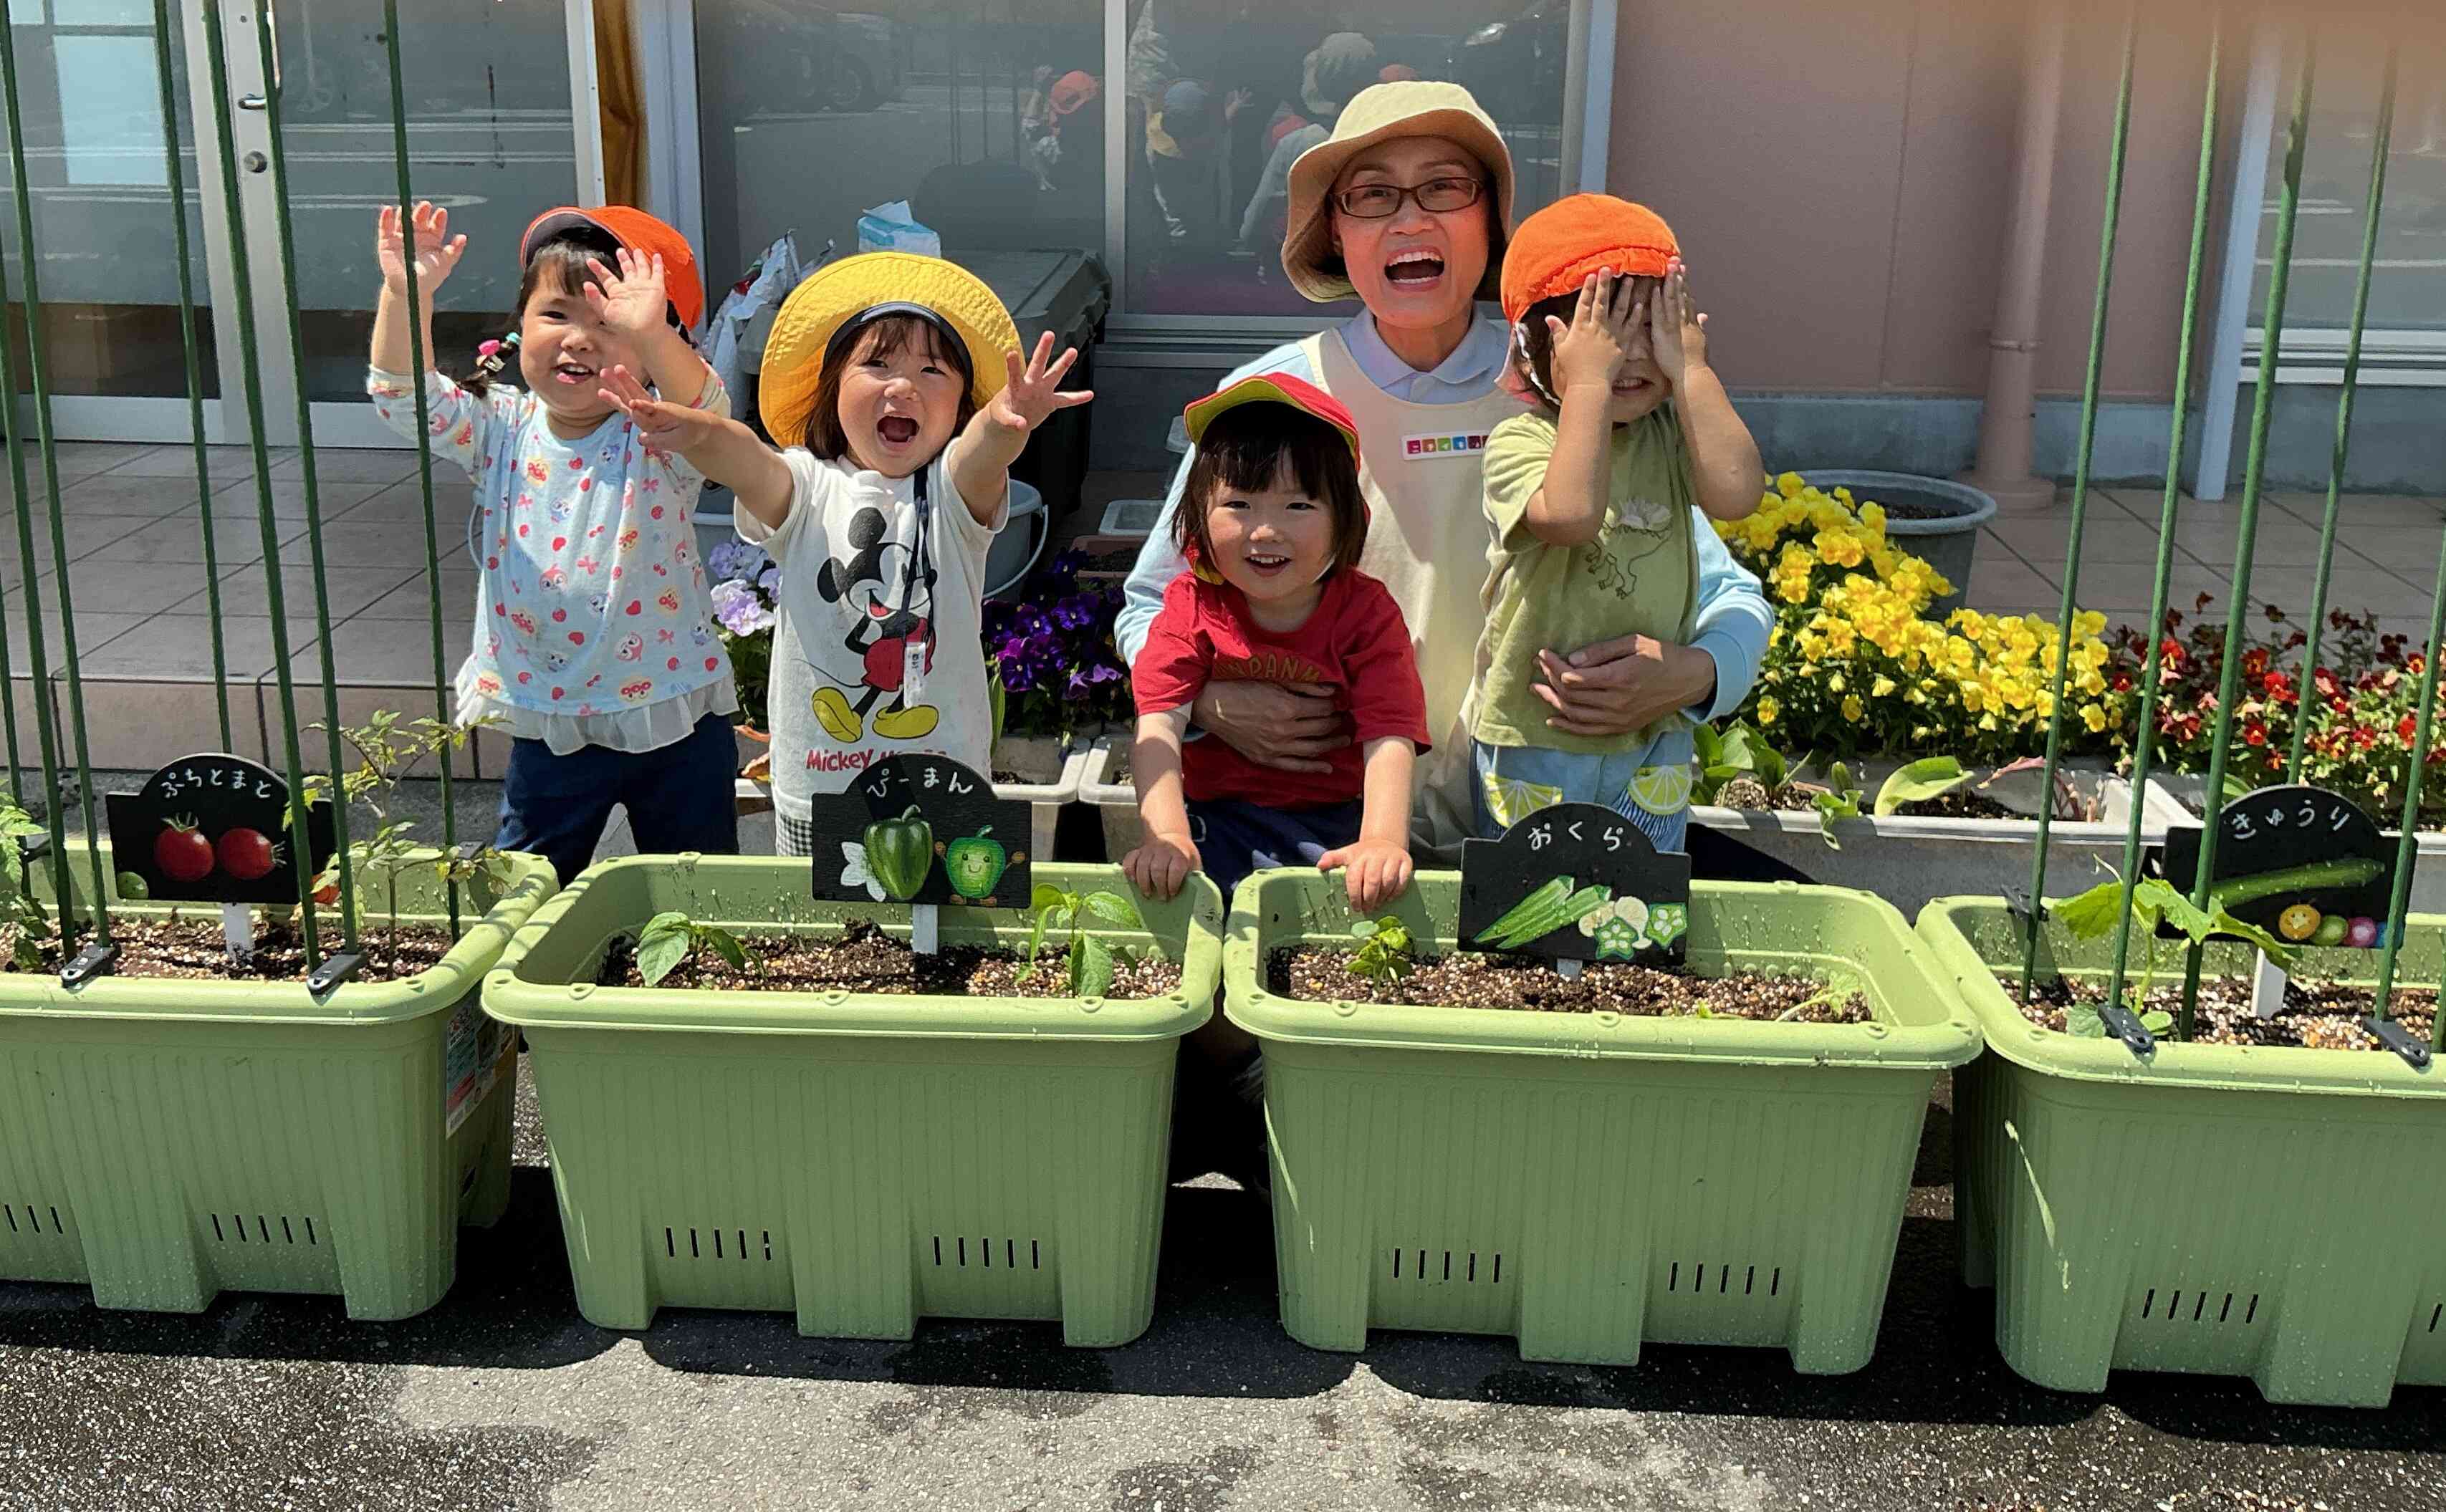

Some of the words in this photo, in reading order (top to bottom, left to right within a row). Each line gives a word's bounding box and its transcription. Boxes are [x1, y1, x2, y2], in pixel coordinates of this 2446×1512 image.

[806, 748, 874, 772] Mickey
[160, 768, 272, 799] ぷちとまと
[866, 767, 973, 797] ぴーまん
[2230, 799, 2350, 839] きゅうり
[1527, 821, 1624, 851] おくら
